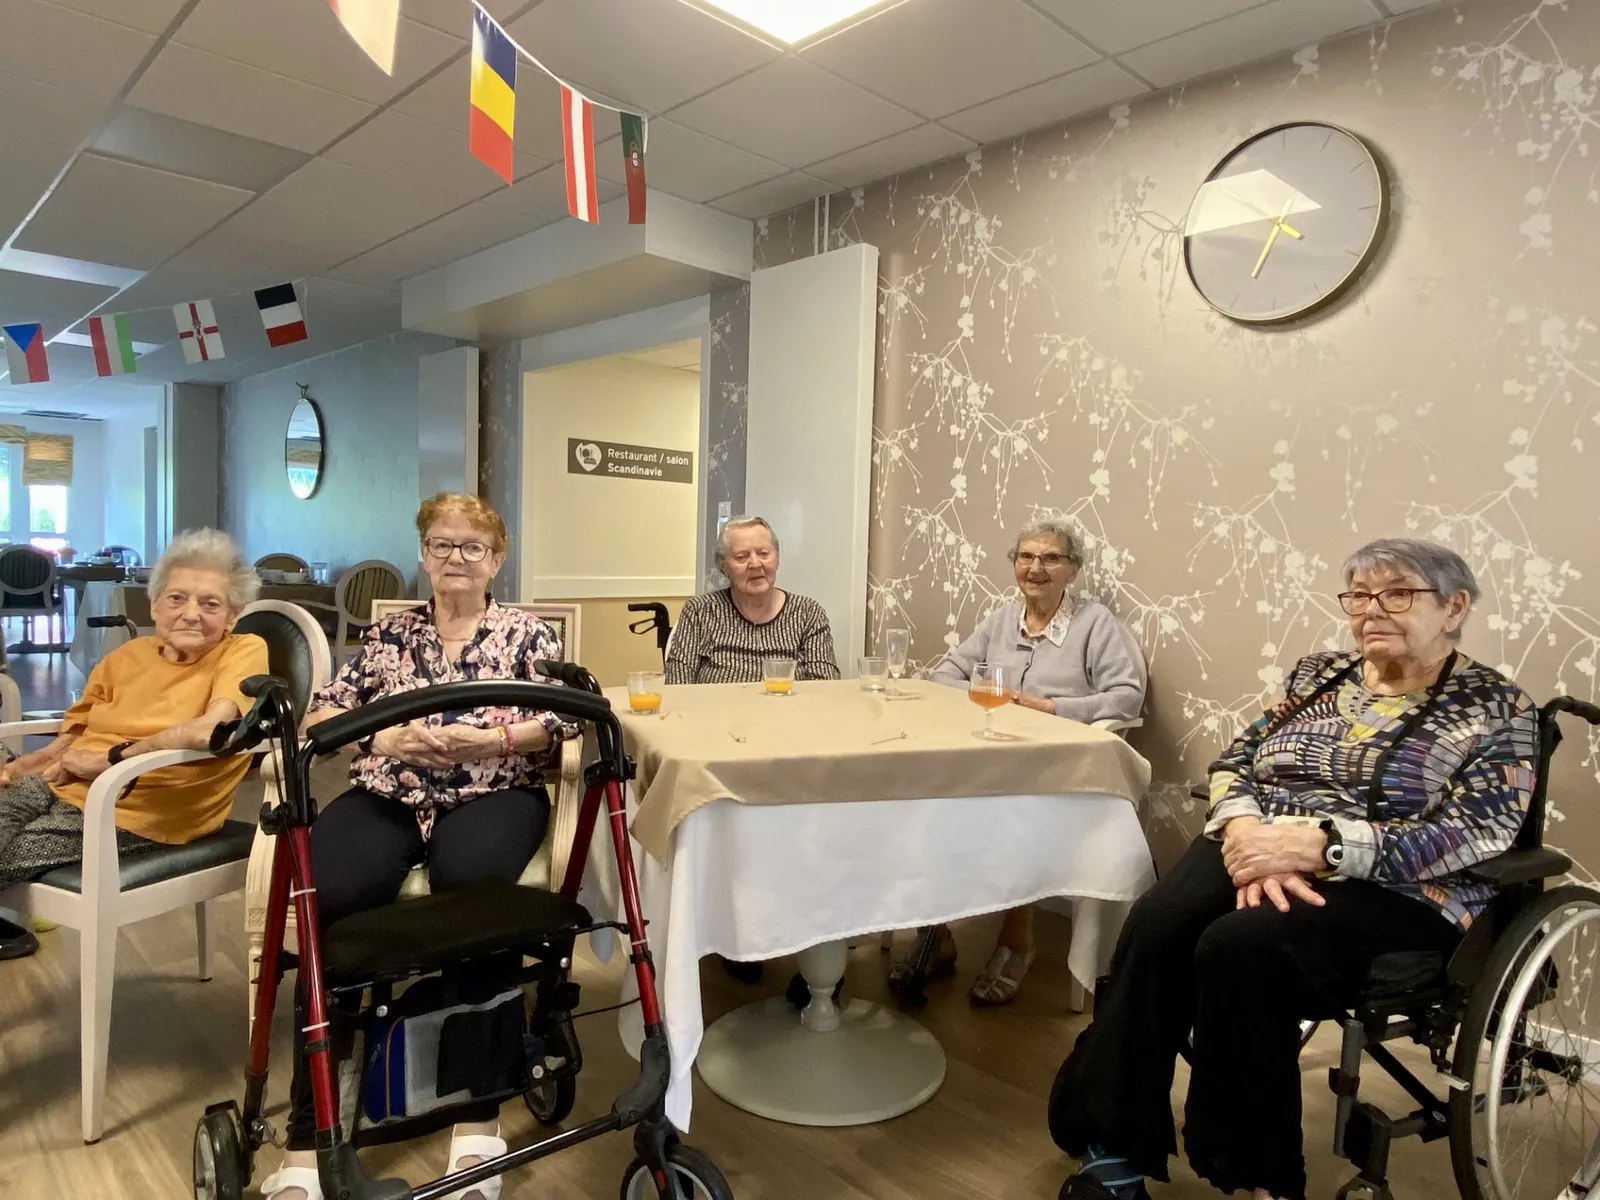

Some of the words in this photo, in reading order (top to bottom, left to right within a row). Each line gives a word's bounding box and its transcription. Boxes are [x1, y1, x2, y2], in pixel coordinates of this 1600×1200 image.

[607, 448, 657, 463] Restaurant
[659, 453, 665, 464] /
[666, 455, 689, 466] salon
[607, 462, 663, 477] Scandinavie
